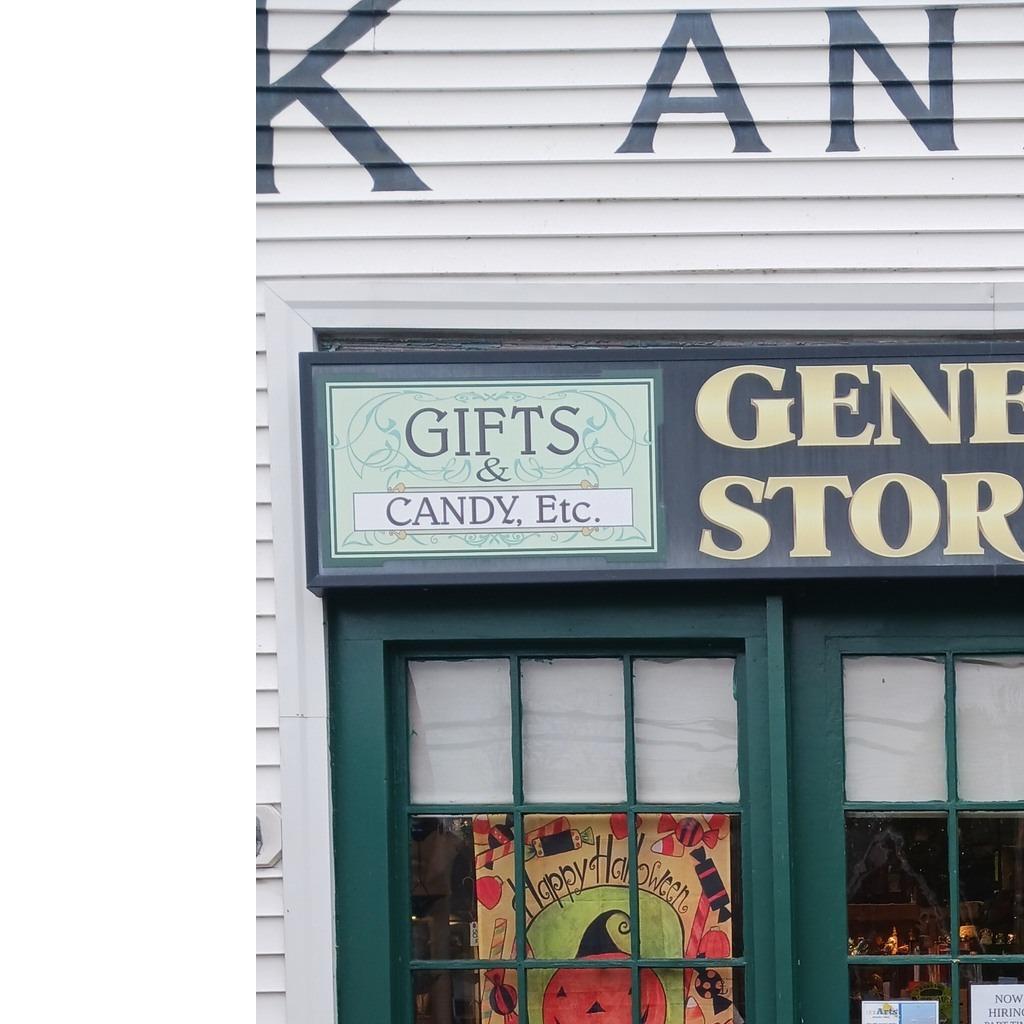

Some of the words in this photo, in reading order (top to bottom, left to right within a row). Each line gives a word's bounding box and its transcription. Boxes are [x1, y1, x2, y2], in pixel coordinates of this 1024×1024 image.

[405, 405, 580, 458] GIFTS
[476, 457, 512, 483] &
[386, 495, 523, 528] CANDY,
[535, 494, 601, 524] Etc.
[507, 858, 588, 919] Happy
[995, 994, 1023, 1004] NOW
